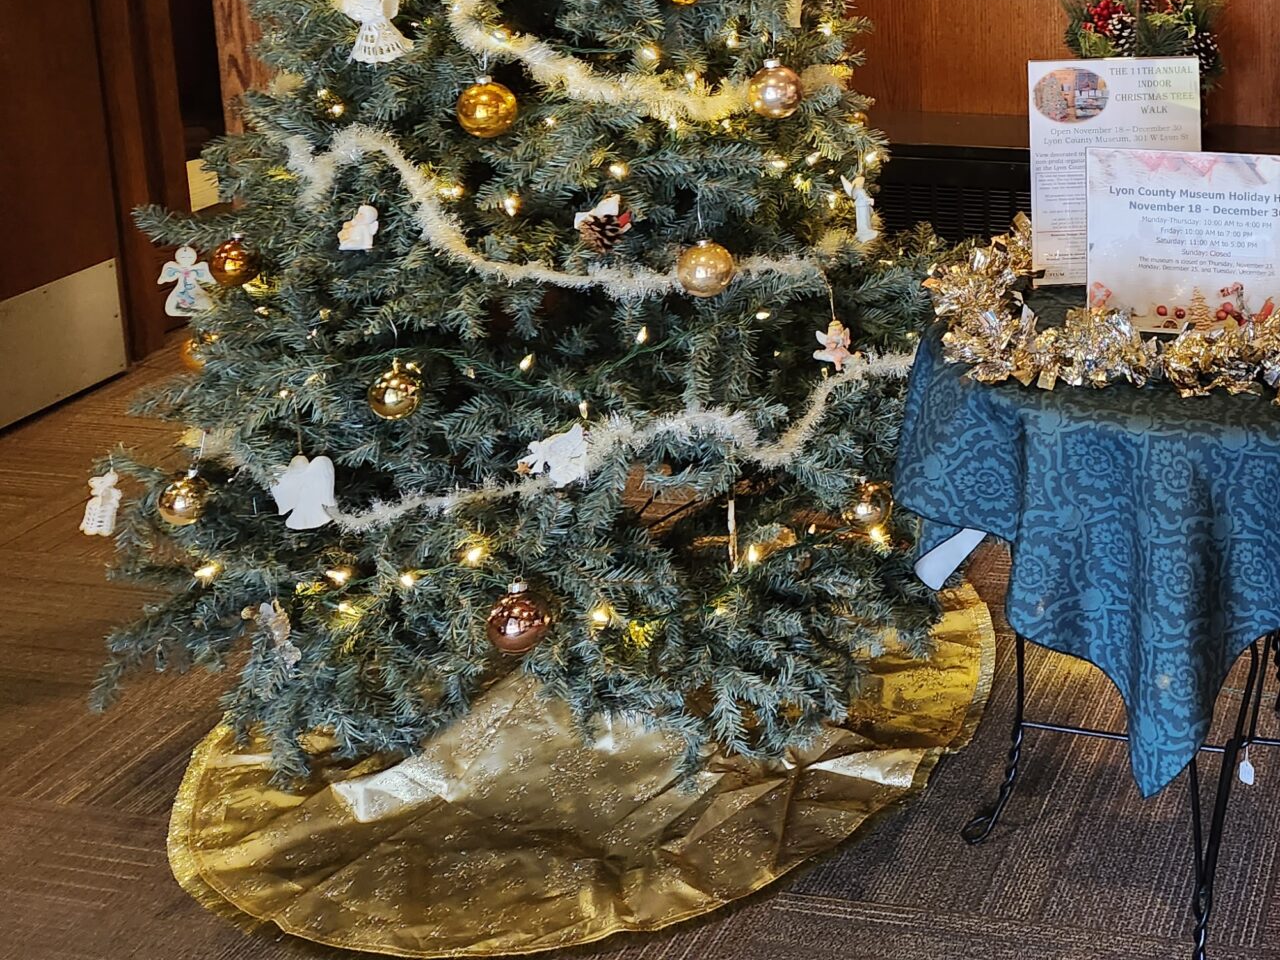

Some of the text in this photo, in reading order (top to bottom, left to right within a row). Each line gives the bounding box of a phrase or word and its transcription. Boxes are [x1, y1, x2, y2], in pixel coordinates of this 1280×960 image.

[1110, 67, 1128, 75] THE
[1115, 92, 1194, 102] CHRISTMAS TREE
[1141, 106, 1168, 114] WALK
[1050, 128, 1071, 136] Open
[1044, 137, 1062, 145] Lyon
[1065, 136, 1093, 144] County
[1109, 186, 1135, 197] Lyon
[1138, 187, 1176, 200] County
[1180, 189, 1226, 200] Museum
[1228, 191, 1270, 204] Holiday
[1128, 201, 1186, 212] November
[1188, 204, 1201, 214] 18
[1212, 206, 1268, 217] December
[1204, 218, 1222, 226] 10:00
[1160, 227, 1183, 236] Friday:
[1156, 236, 1186, 246] Saturday:
[1181, 248, 1208, 258] Sunday:
